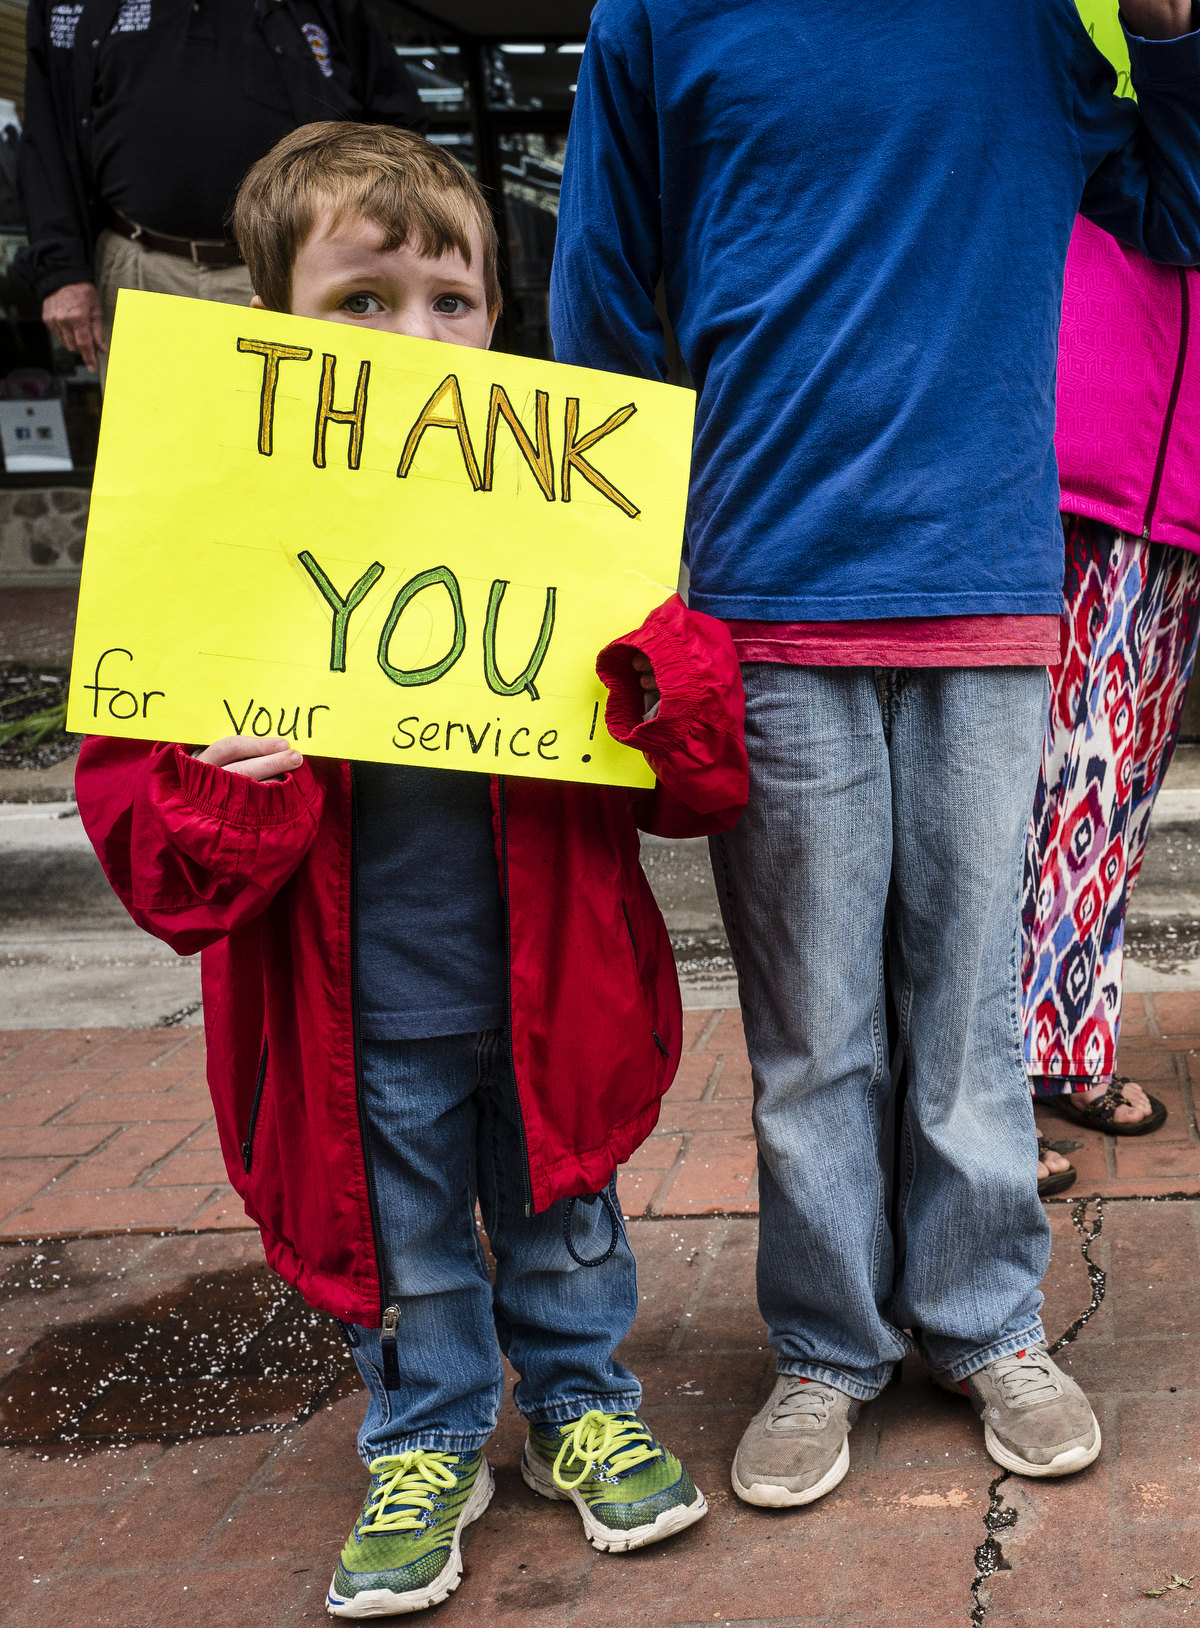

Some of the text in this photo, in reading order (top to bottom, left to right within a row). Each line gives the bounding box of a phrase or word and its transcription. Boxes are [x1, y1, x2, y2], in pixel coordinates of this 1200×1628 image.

[237, 336, 641, 519] THANK
[83, 647, 166, 719] for
[297, 549, 558, 702] YOU
